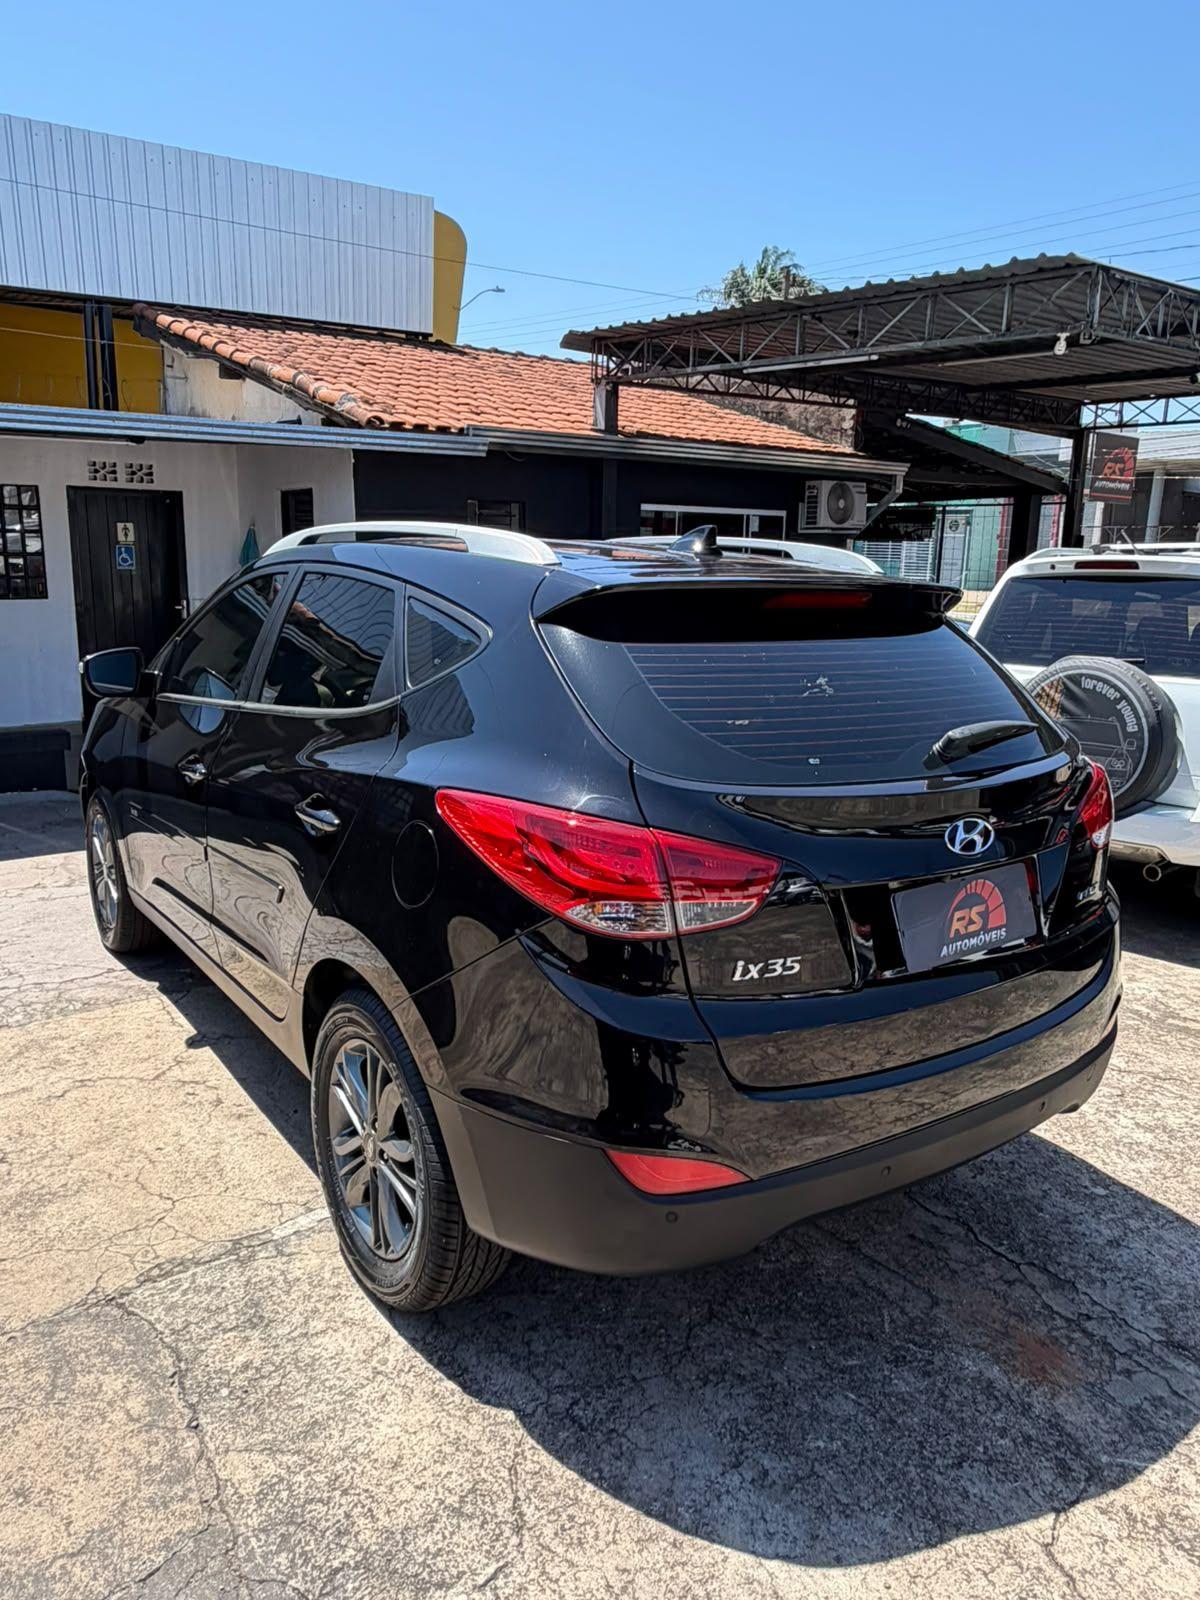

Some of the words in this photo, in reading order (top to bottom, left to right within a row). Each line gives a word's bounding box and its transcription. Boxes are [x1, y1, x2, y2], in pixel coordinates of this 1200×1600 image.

[1081, 676, 1121, 701] forever
[1116, 699, 1138, 733] young
[949, 903, 987, 939] RS
[940, 928, 1007, 958] AUTOMÓVEIS
[732, 956, 802, 982] ix35
